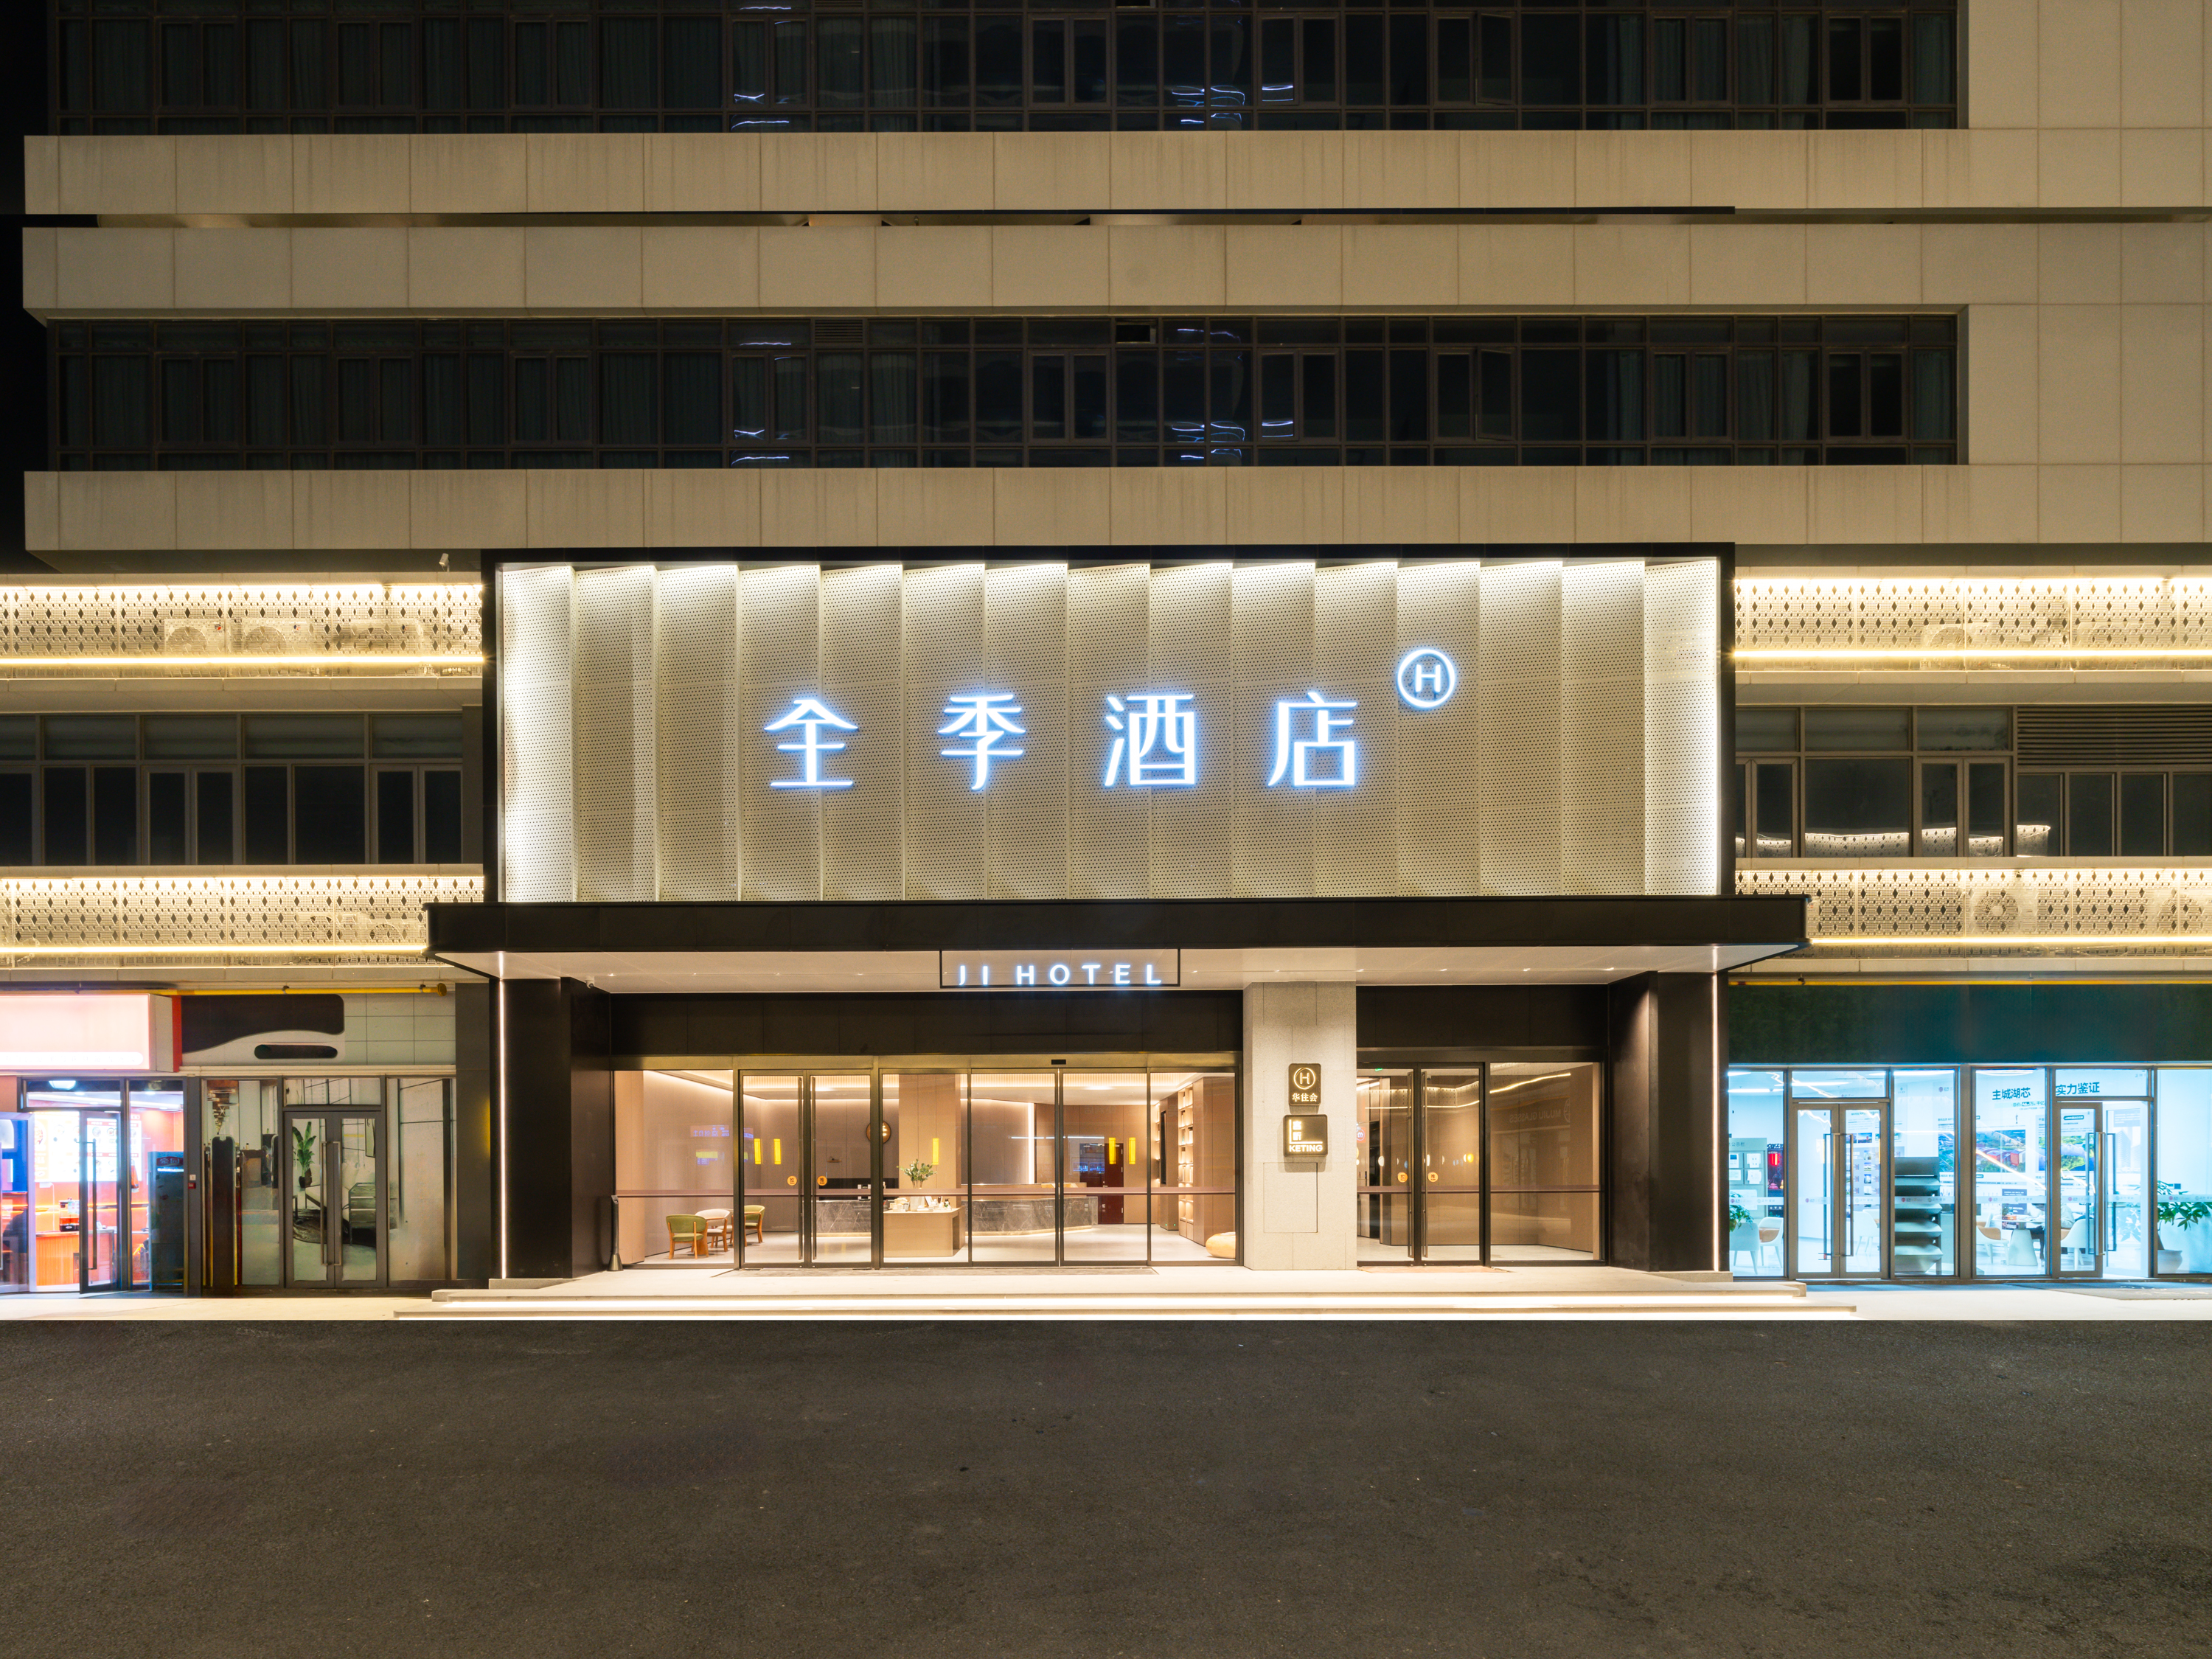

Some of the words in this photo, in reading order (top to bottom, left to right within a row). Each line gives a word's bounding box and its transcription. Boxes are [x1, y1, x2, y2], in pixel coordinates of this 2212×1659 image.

[763, 691, 1358, 790] 全季酒店
[959, 964, 989, 985] JI
[1017, 964, 1162, 985] HOTEL
[1992, 1088, 2031, 1100] 主城湖芯
[2056, 1082, 2100, 1096] 实力鉴证
[1292, 1093, 1318, 1102] 华住会
[1289, 1144, 1324, 1152] KETING
